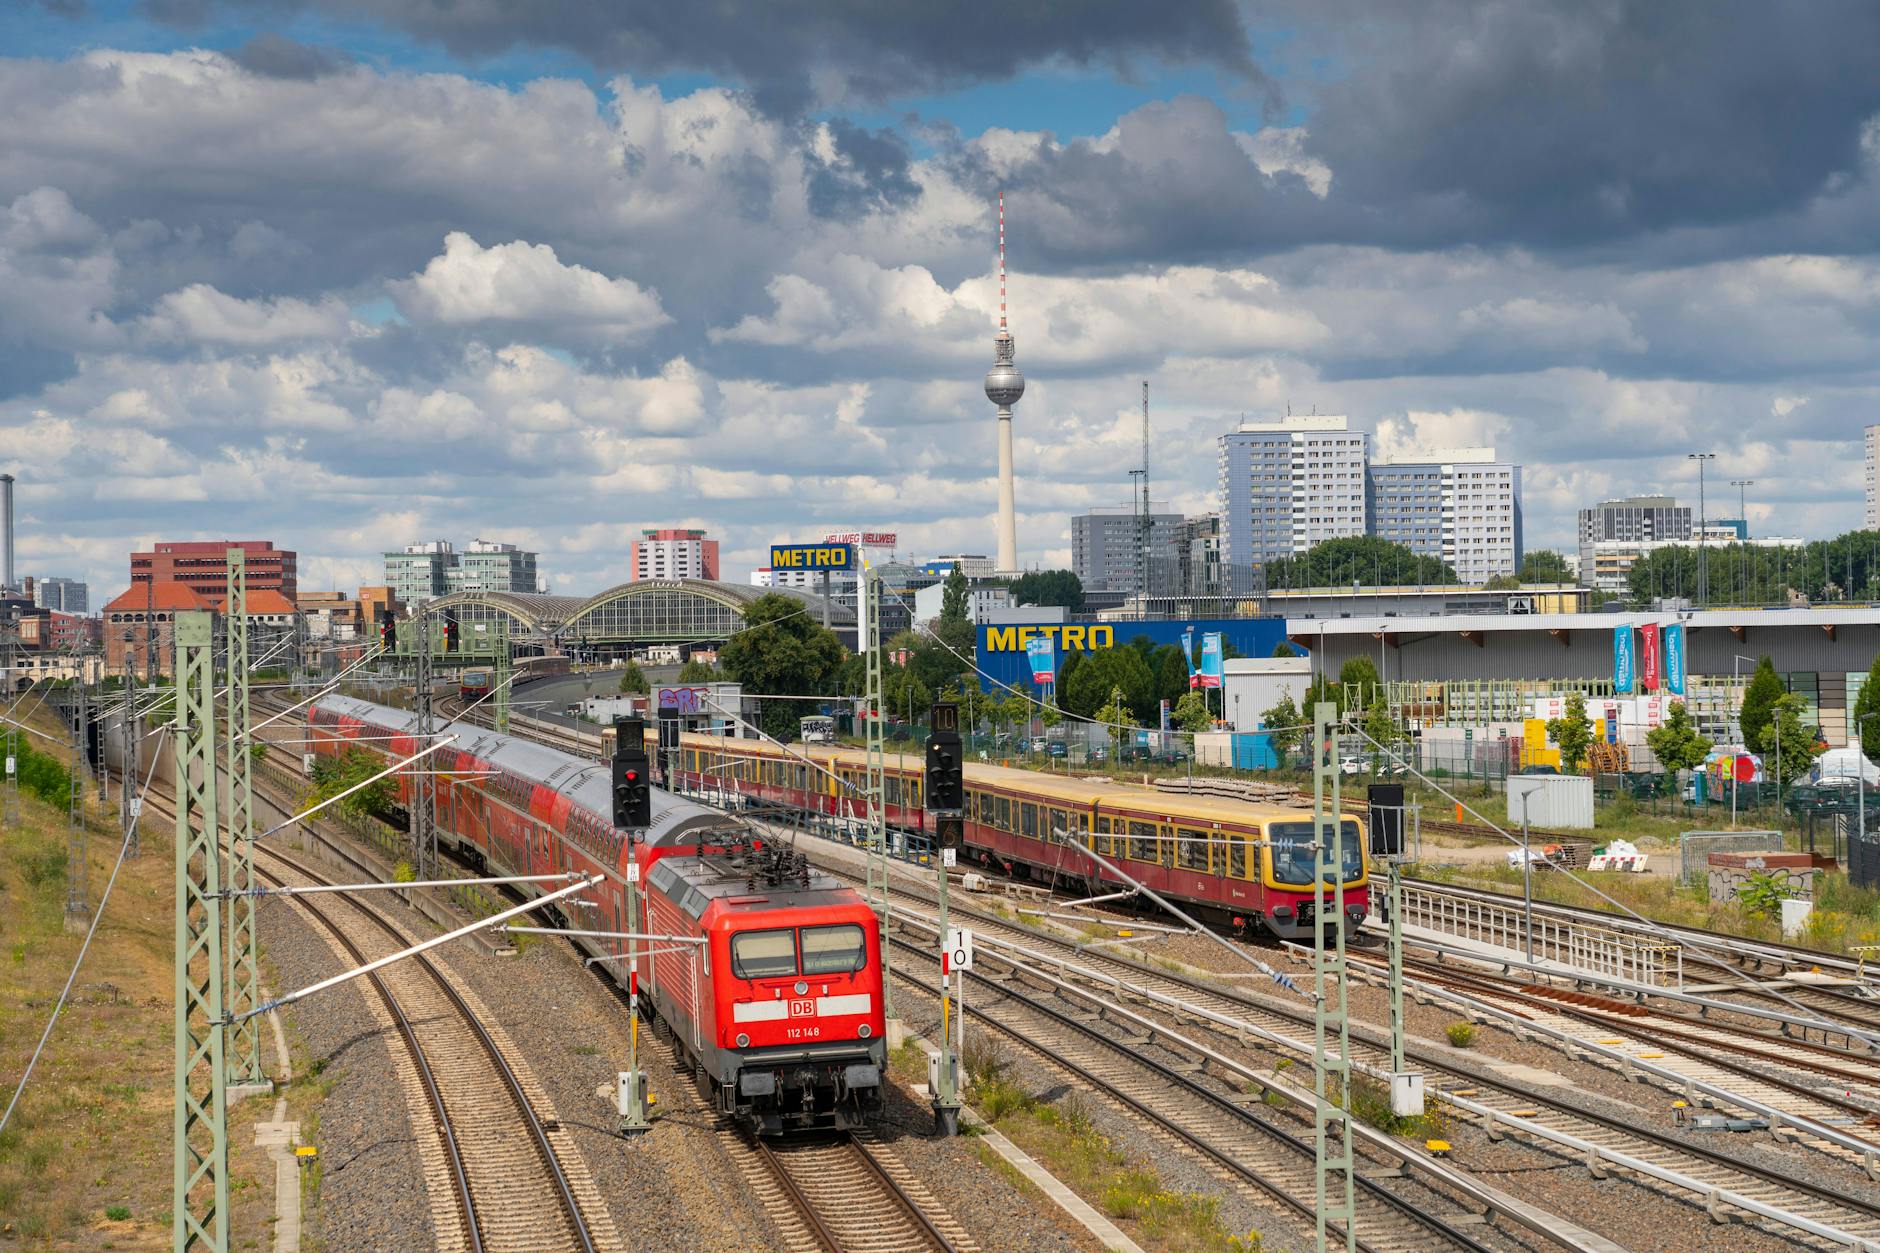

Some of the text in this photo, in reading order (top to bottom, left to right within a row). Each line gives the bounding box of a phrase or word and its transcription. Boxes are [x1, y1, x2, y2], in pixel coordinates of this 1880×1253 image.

[826, 534, 860, 544] HELLWEG
[863, 533, 896, 543] HELLWEG
[773, 548, 847, 567] METRO
[986, 625, 1114, 652] METRO
[936, 708, 954, 729] 10
[957, 931, 963, 946] 1
[954, 949, 966, 965] 0
[793, 1001, 813, 1014] DB
[787, 1027, 820, 1038] 112 148
